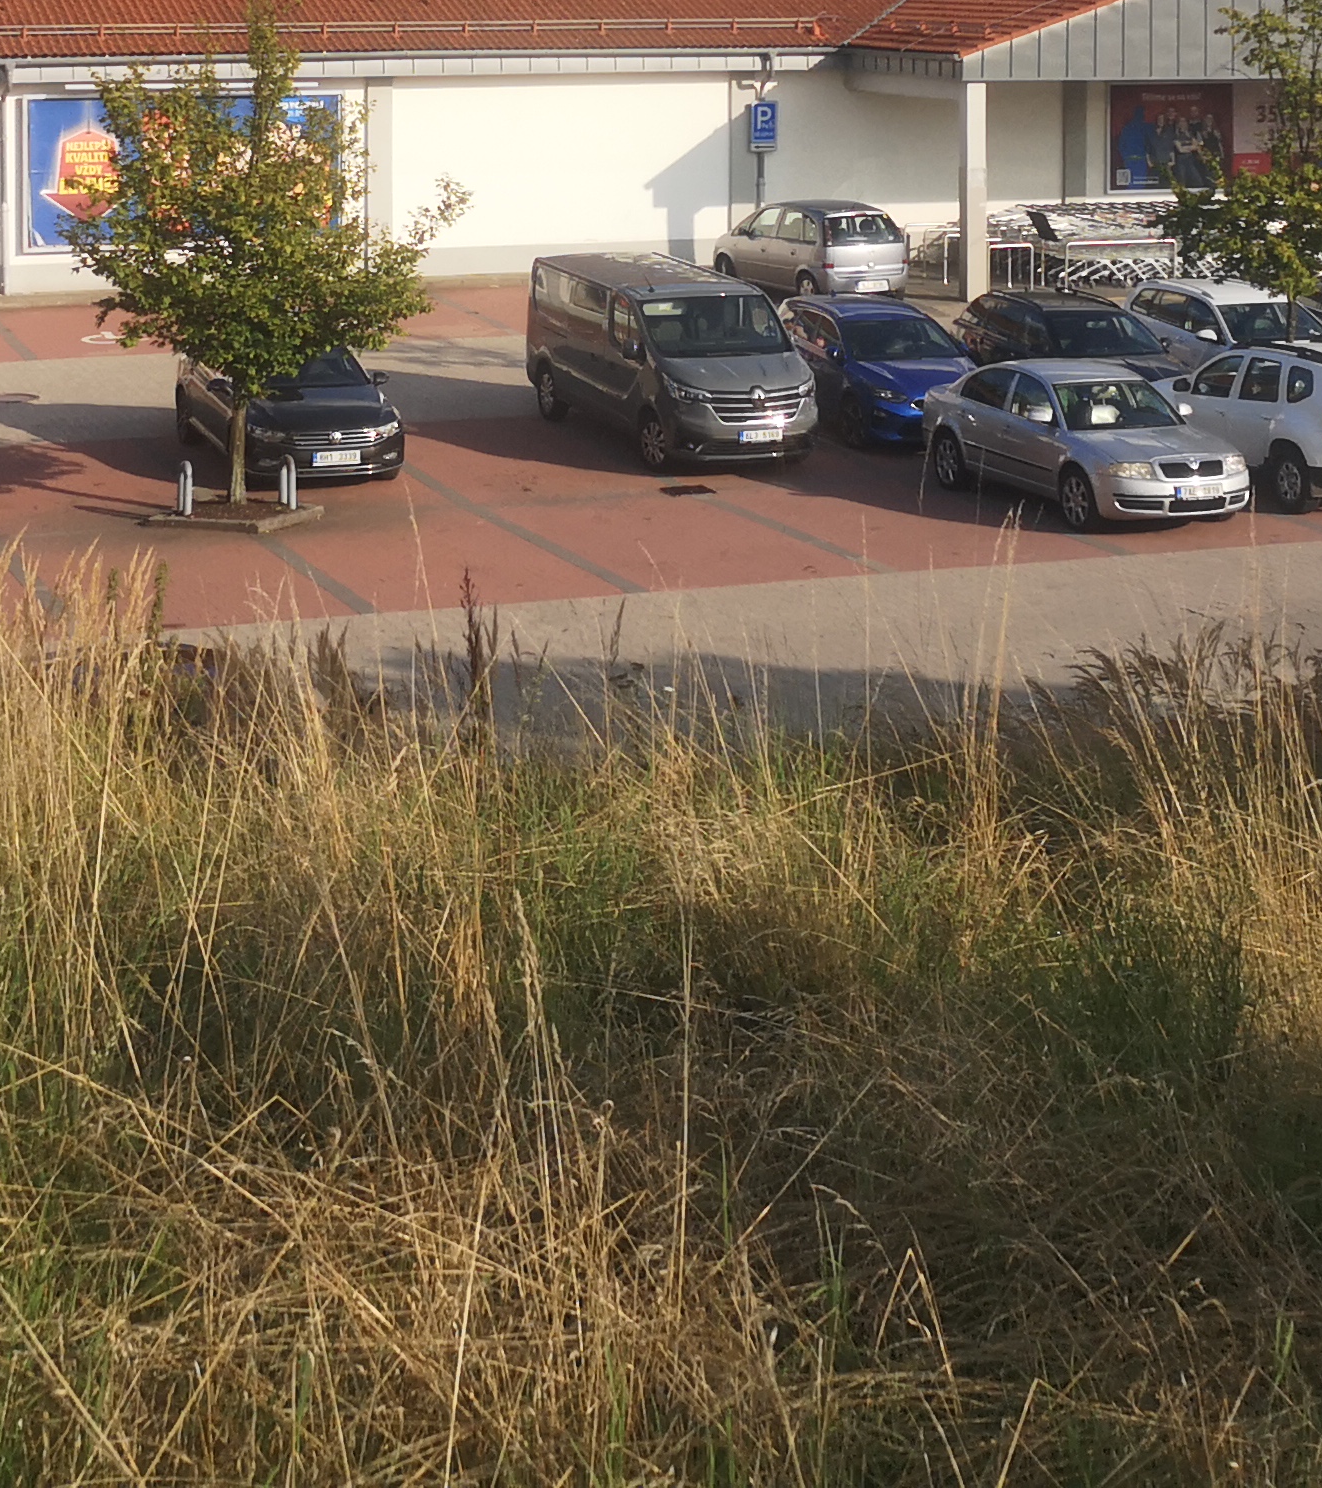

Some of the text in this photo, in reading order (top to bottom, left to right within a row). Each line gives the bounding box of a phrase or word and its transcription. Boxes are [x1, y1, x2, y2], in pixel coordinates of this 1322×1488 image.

[757, 106, 772, 129] P
[65, 152, 110, 163] KVALIT
[74, 163, 103, 176] VŽDY
